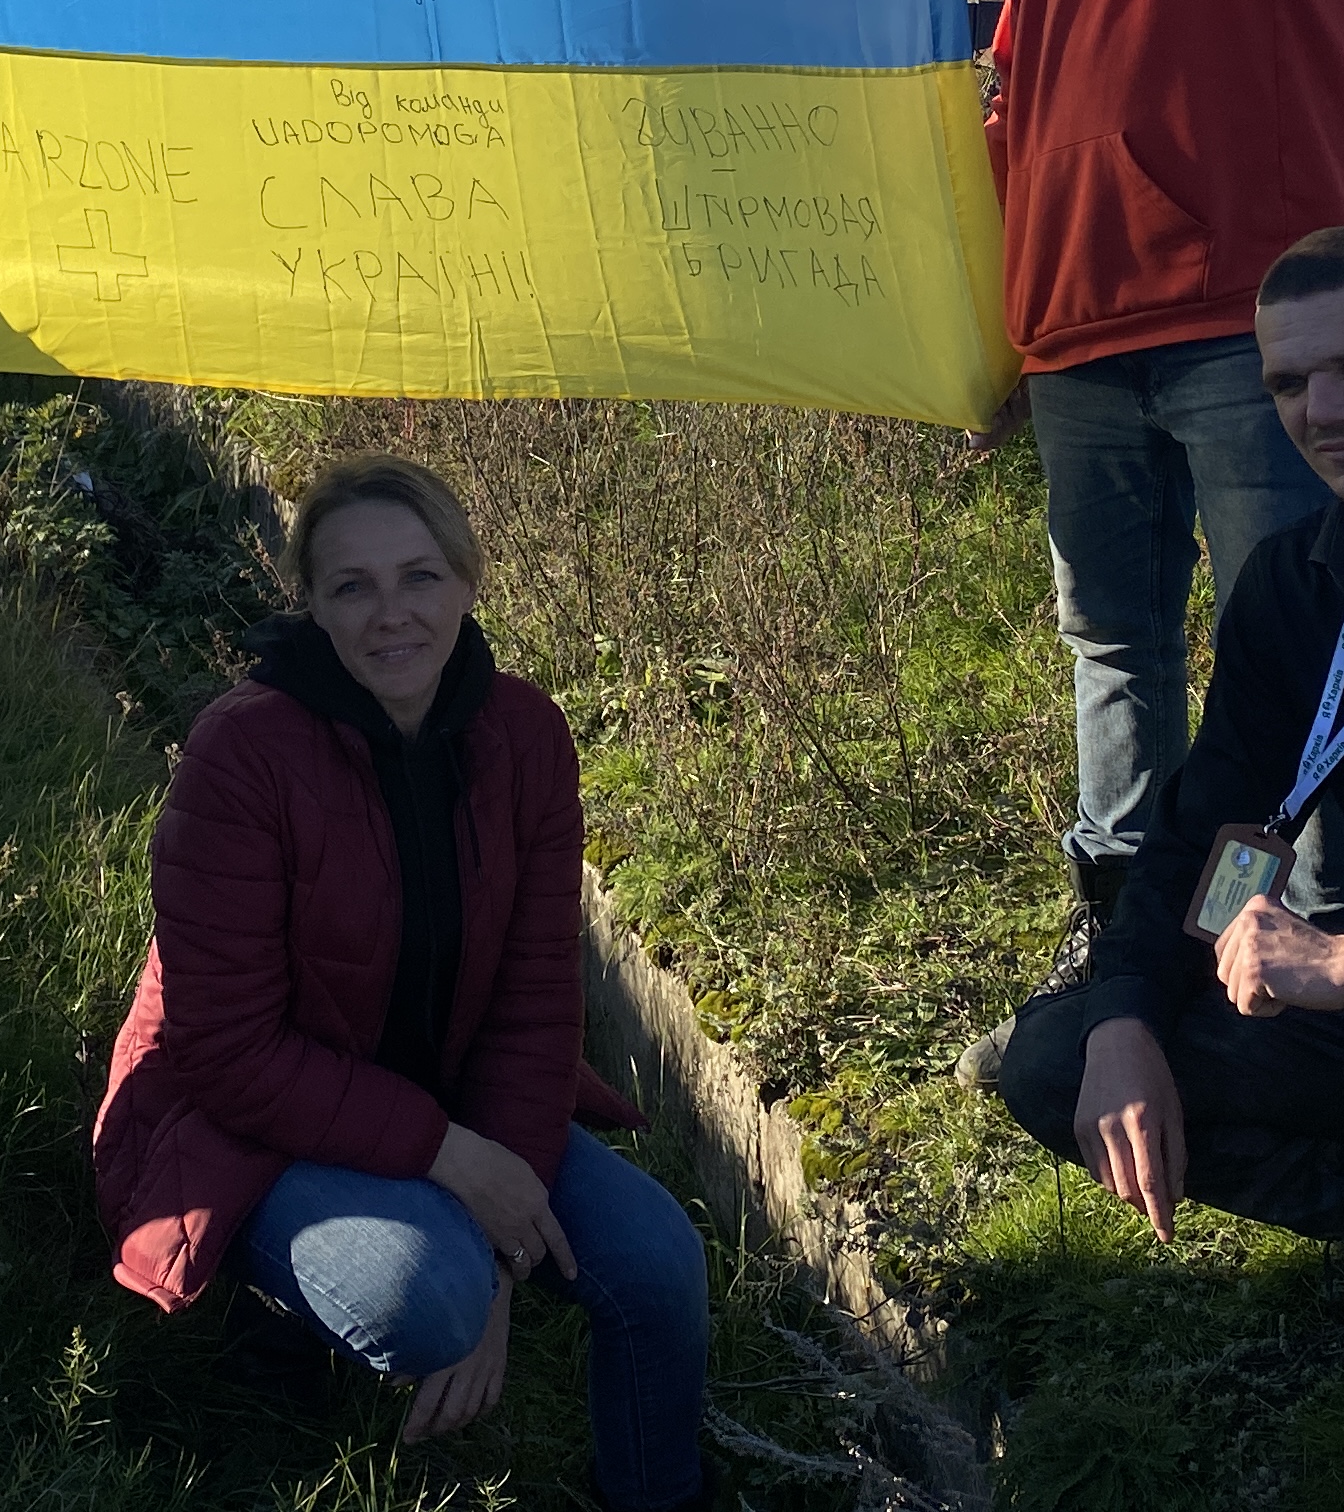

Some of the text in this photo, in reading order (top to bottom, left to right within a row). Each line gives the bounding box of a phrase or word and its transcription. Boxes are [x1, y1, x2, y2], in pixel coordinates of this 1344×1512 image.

[330, 77, 505, 128] Від команди
[260, 172, 510, 230] СЛАВА
[655, 178, 883, 242] ШТУРМОВАЯ
[682, 242, 886, 308] БРИГАДА
[1326, 669, 1344, 702] Харків
